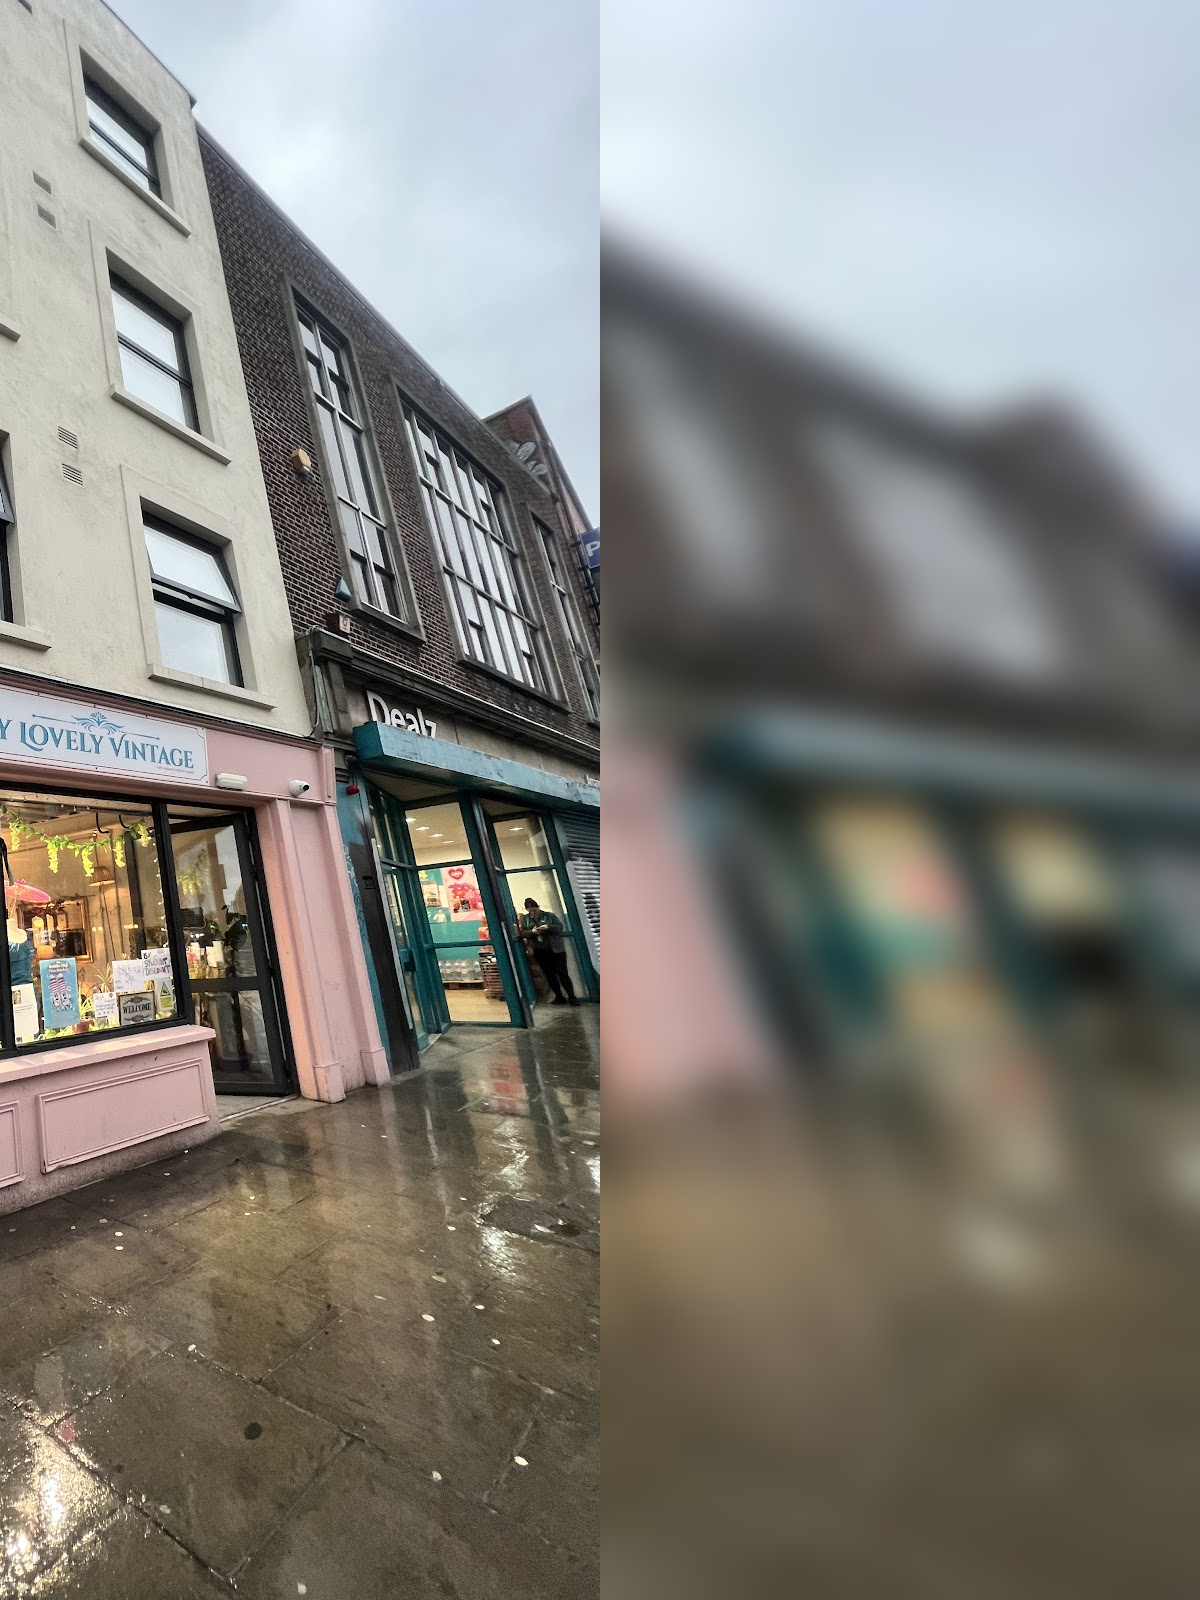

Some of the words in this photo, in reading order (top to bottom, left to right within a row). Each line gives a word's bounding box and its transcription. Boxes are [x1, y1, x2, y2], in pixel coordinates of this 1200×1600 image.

[19, 721, 105, 755] LOVELY
[108, 733, 194, 769] VINTAGE
[122, 1003, 152, 1014] WELCOME
